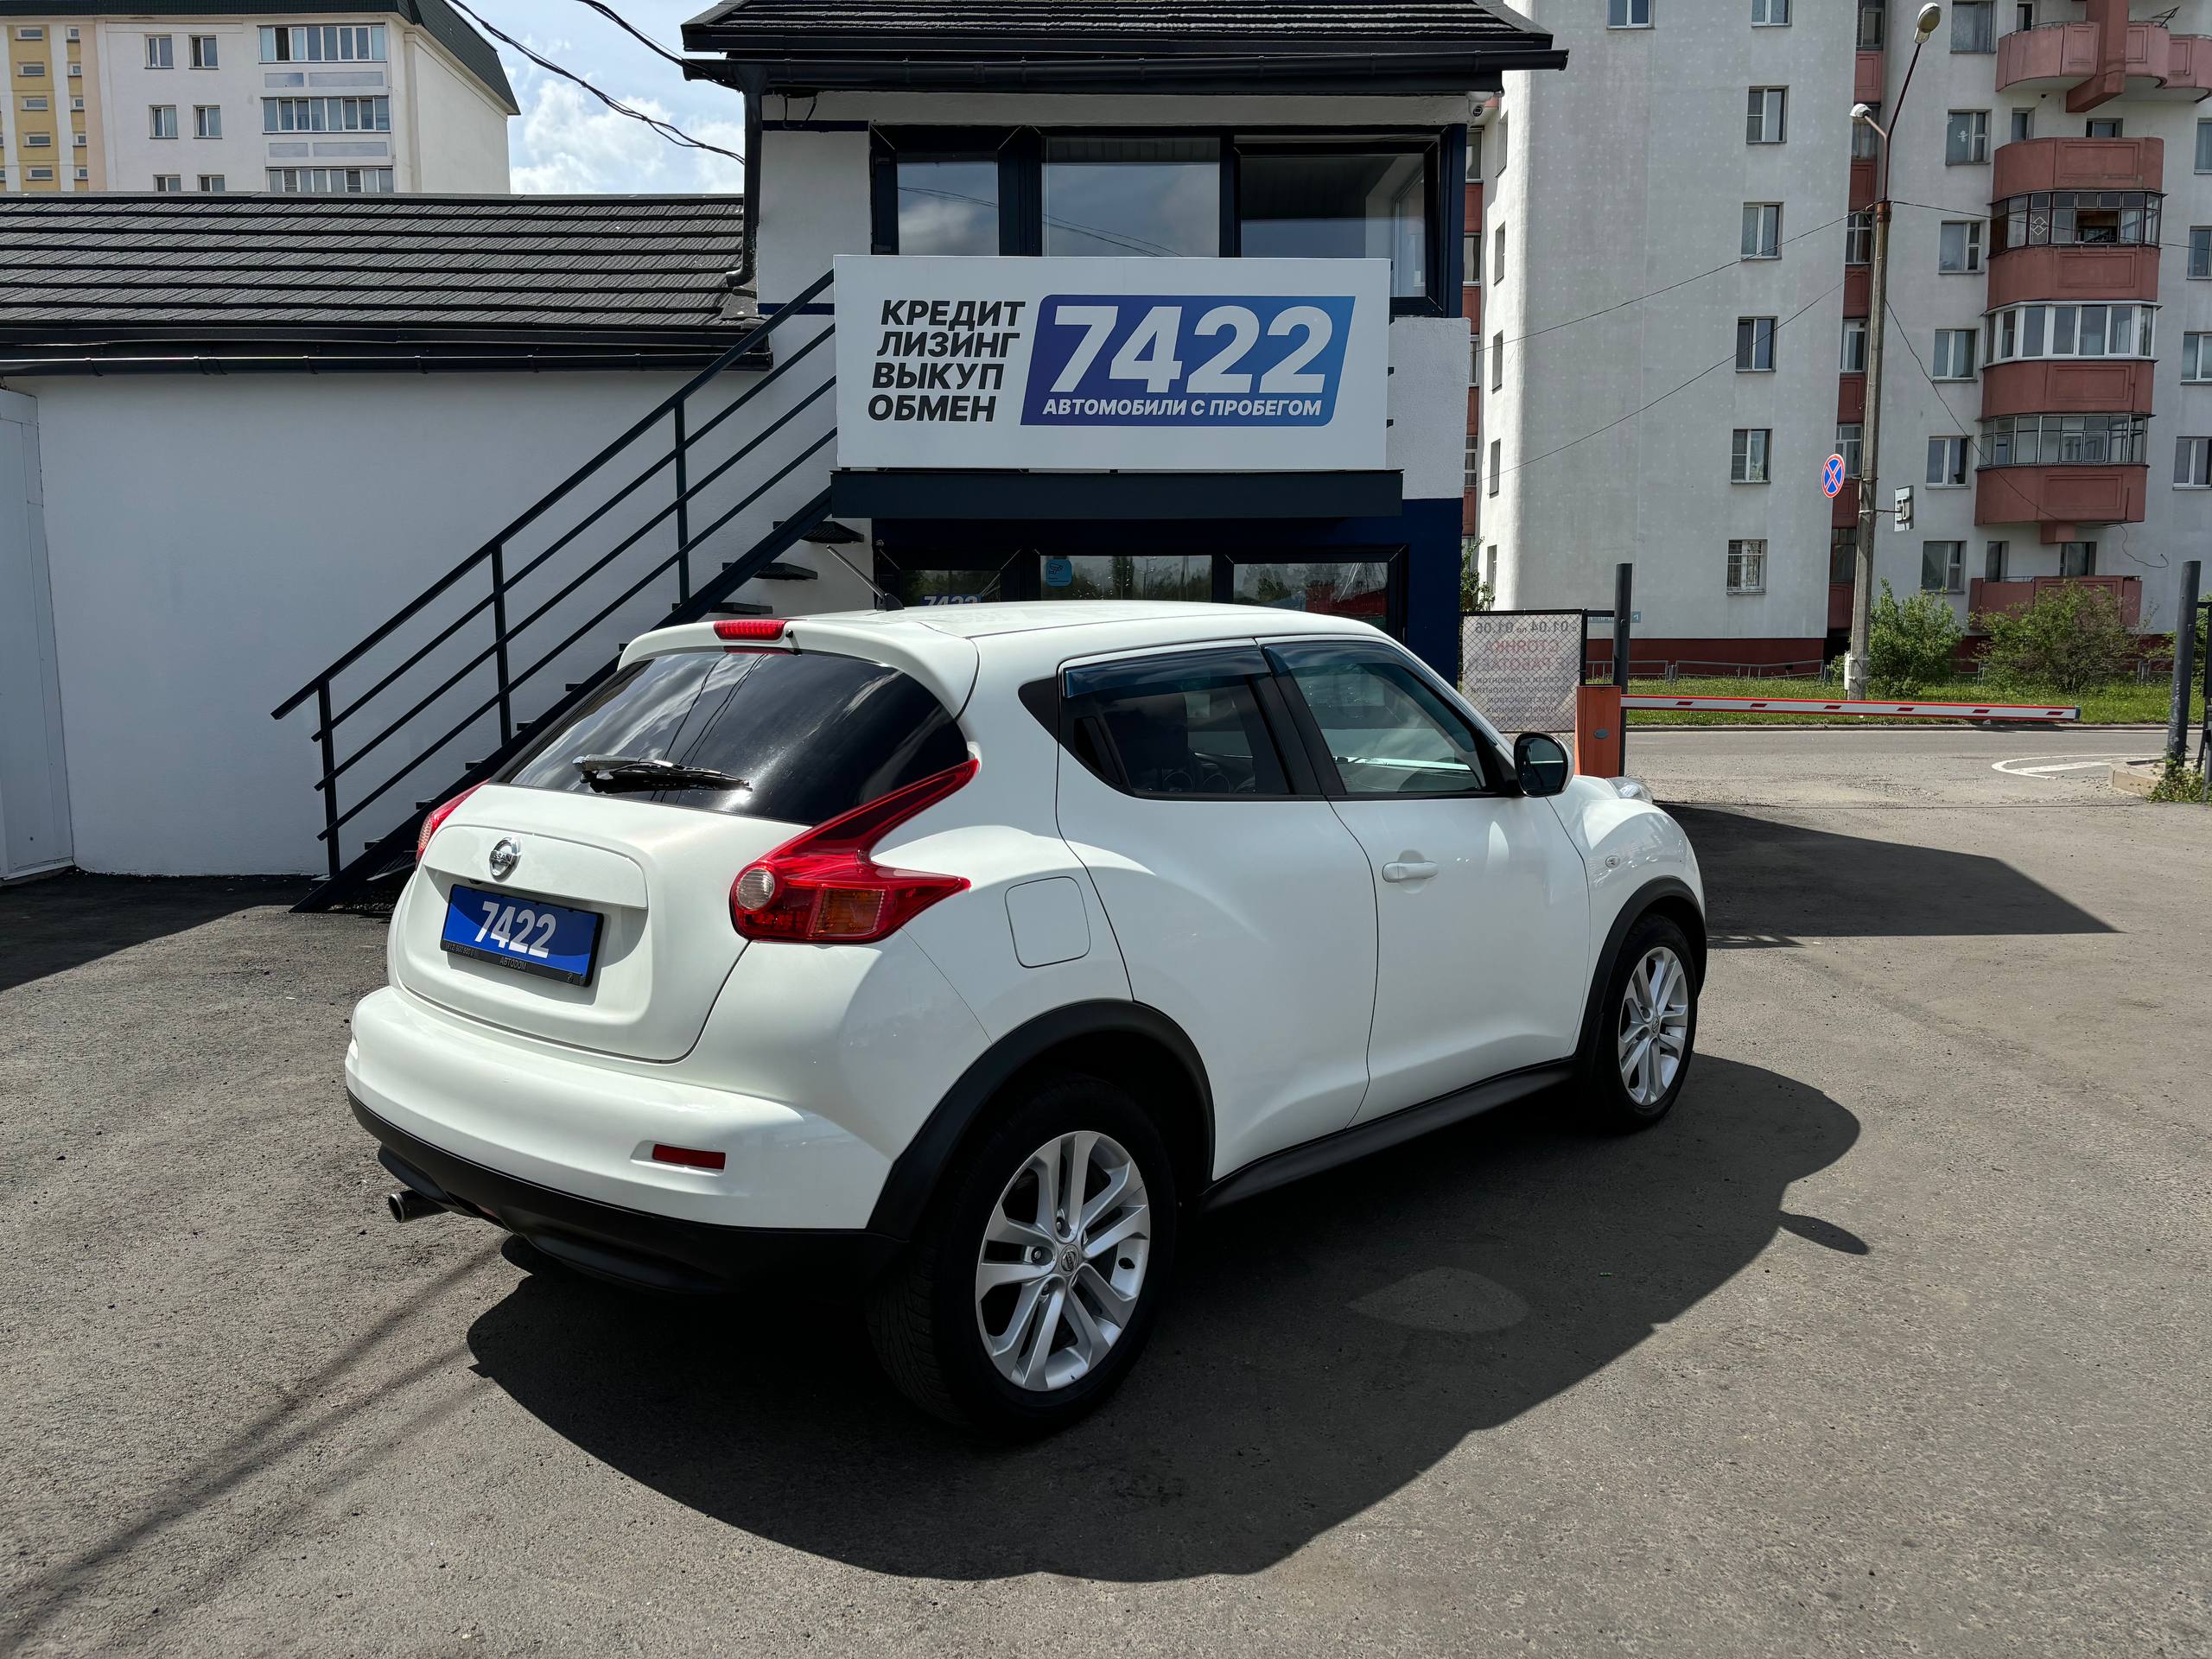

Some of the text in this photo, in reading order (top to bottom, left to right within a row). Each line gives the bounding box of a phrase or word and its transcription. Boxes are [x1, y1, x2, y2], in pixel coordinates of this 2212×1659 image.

[880, 300, 1026, 331] КРЕДИТ
[876, 332, 1020, 358] ЛИЗИНГ
[1049, 306, 1333, 394] 7422
[872, 362, 1004, 390] ВЫКУП
[868, 394, 995, 423] ОБМЕН
[1042, 398, 1323, 417] АВТОМОБИЛИ С ПРОБЕГОМ
[475, 901, 556, 958] 7422
